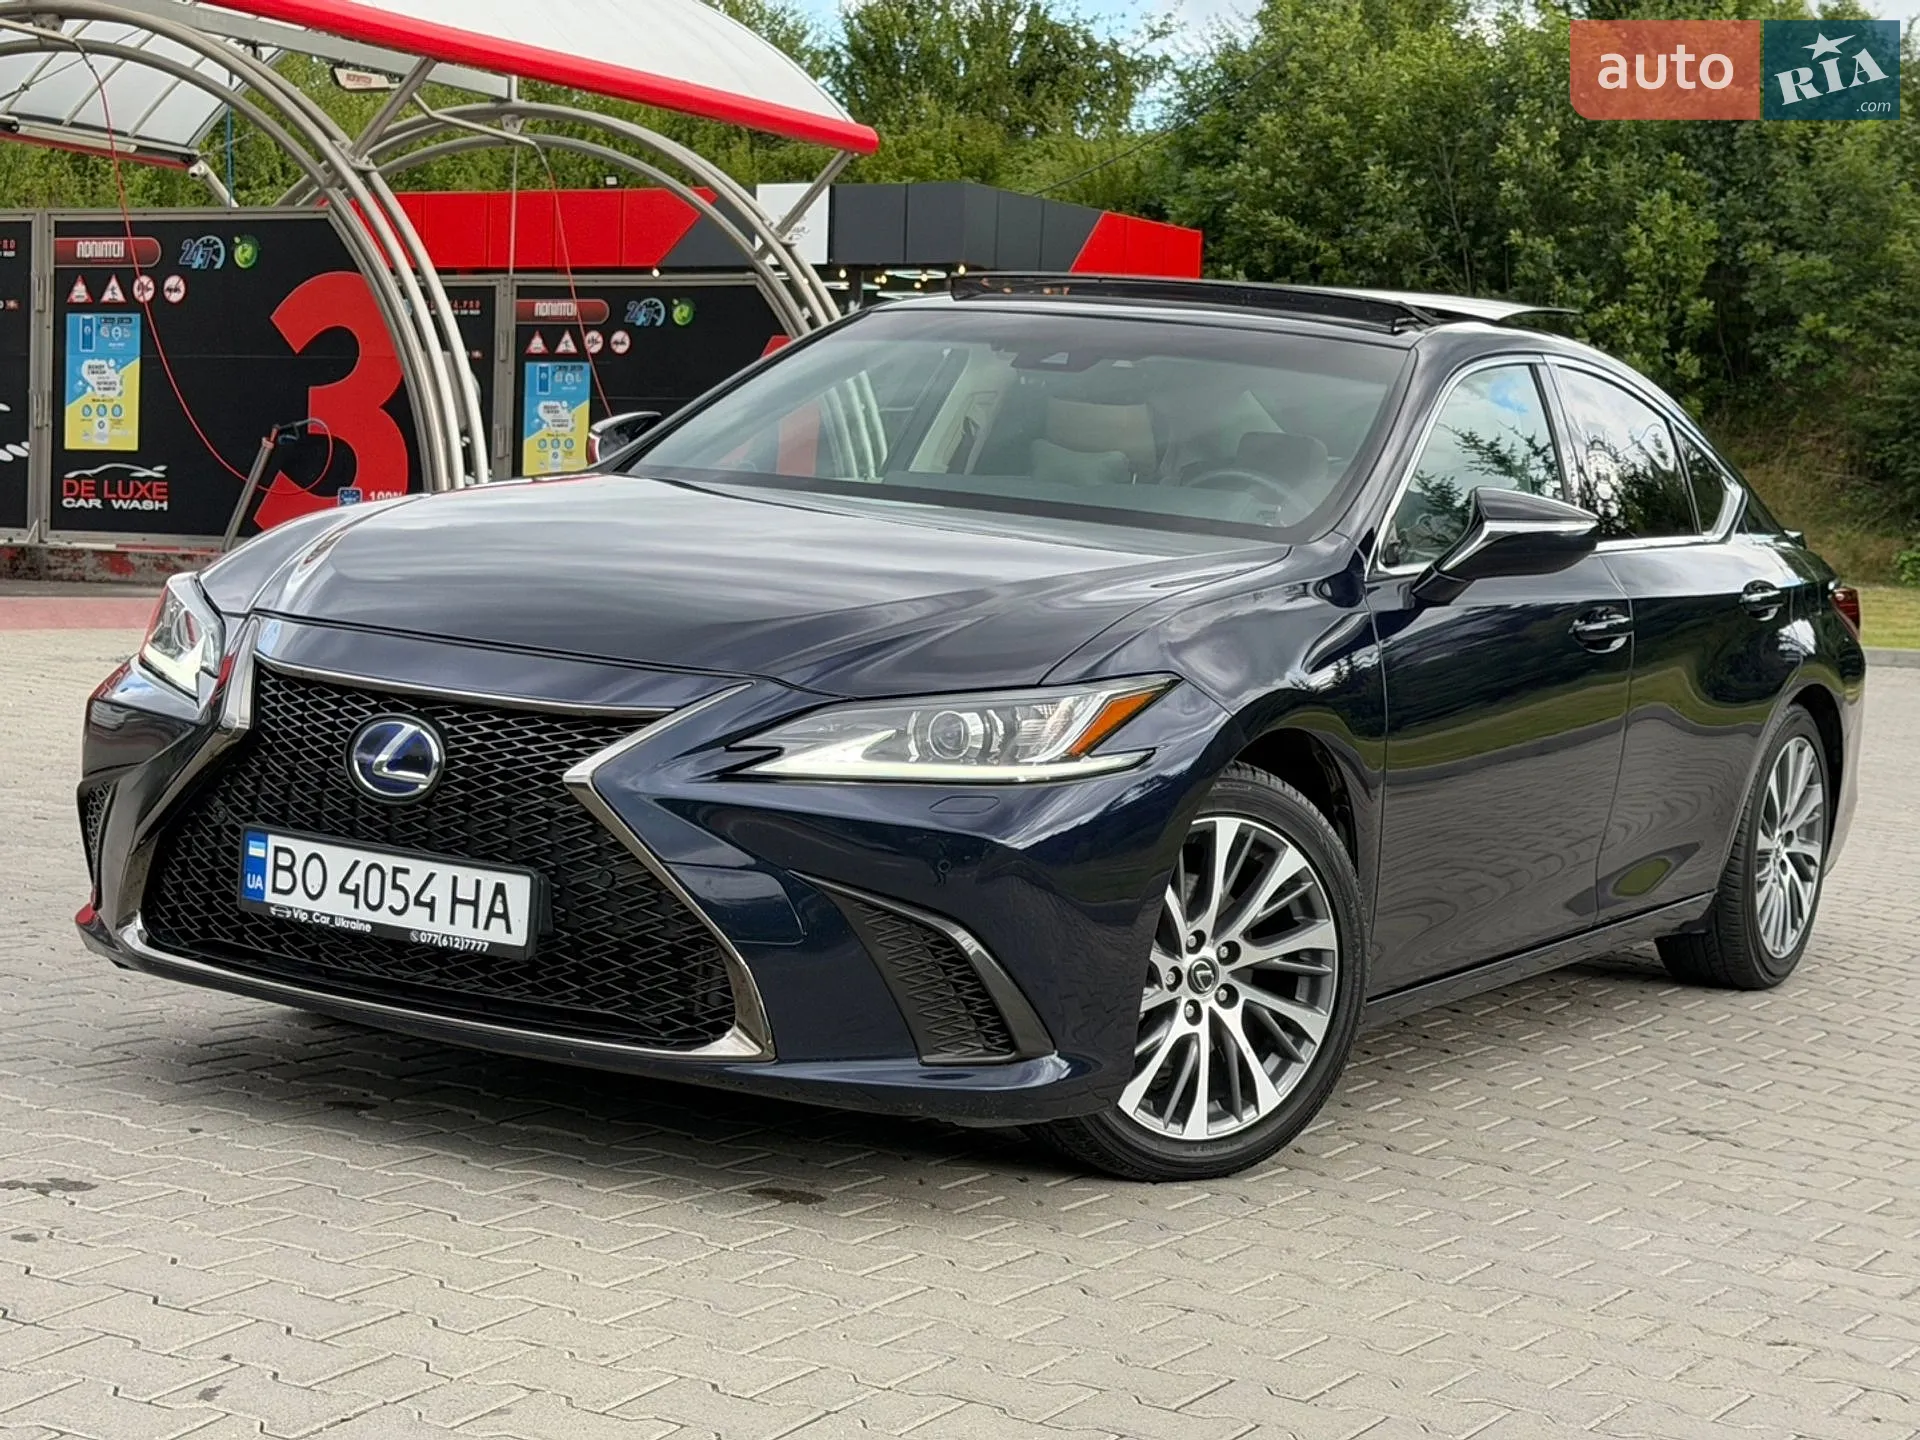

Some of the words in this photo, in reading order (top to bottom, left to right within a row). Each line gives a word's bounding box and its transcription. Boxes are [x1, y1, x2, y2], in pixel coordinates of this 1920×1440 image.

[253, 270, 409, 531] 3
[62, 479, 96, 498] DE
[104, 480, 168, 499] LUXE
[62, 498, 103, 509] CAR
[112, 499, 168, 511] WASH
[246, 872, 264, 891] UA
[271, 845, 329, 901] BO
[338, 859, 437, 923] 4054
[449, 874, 513, 935] HA
